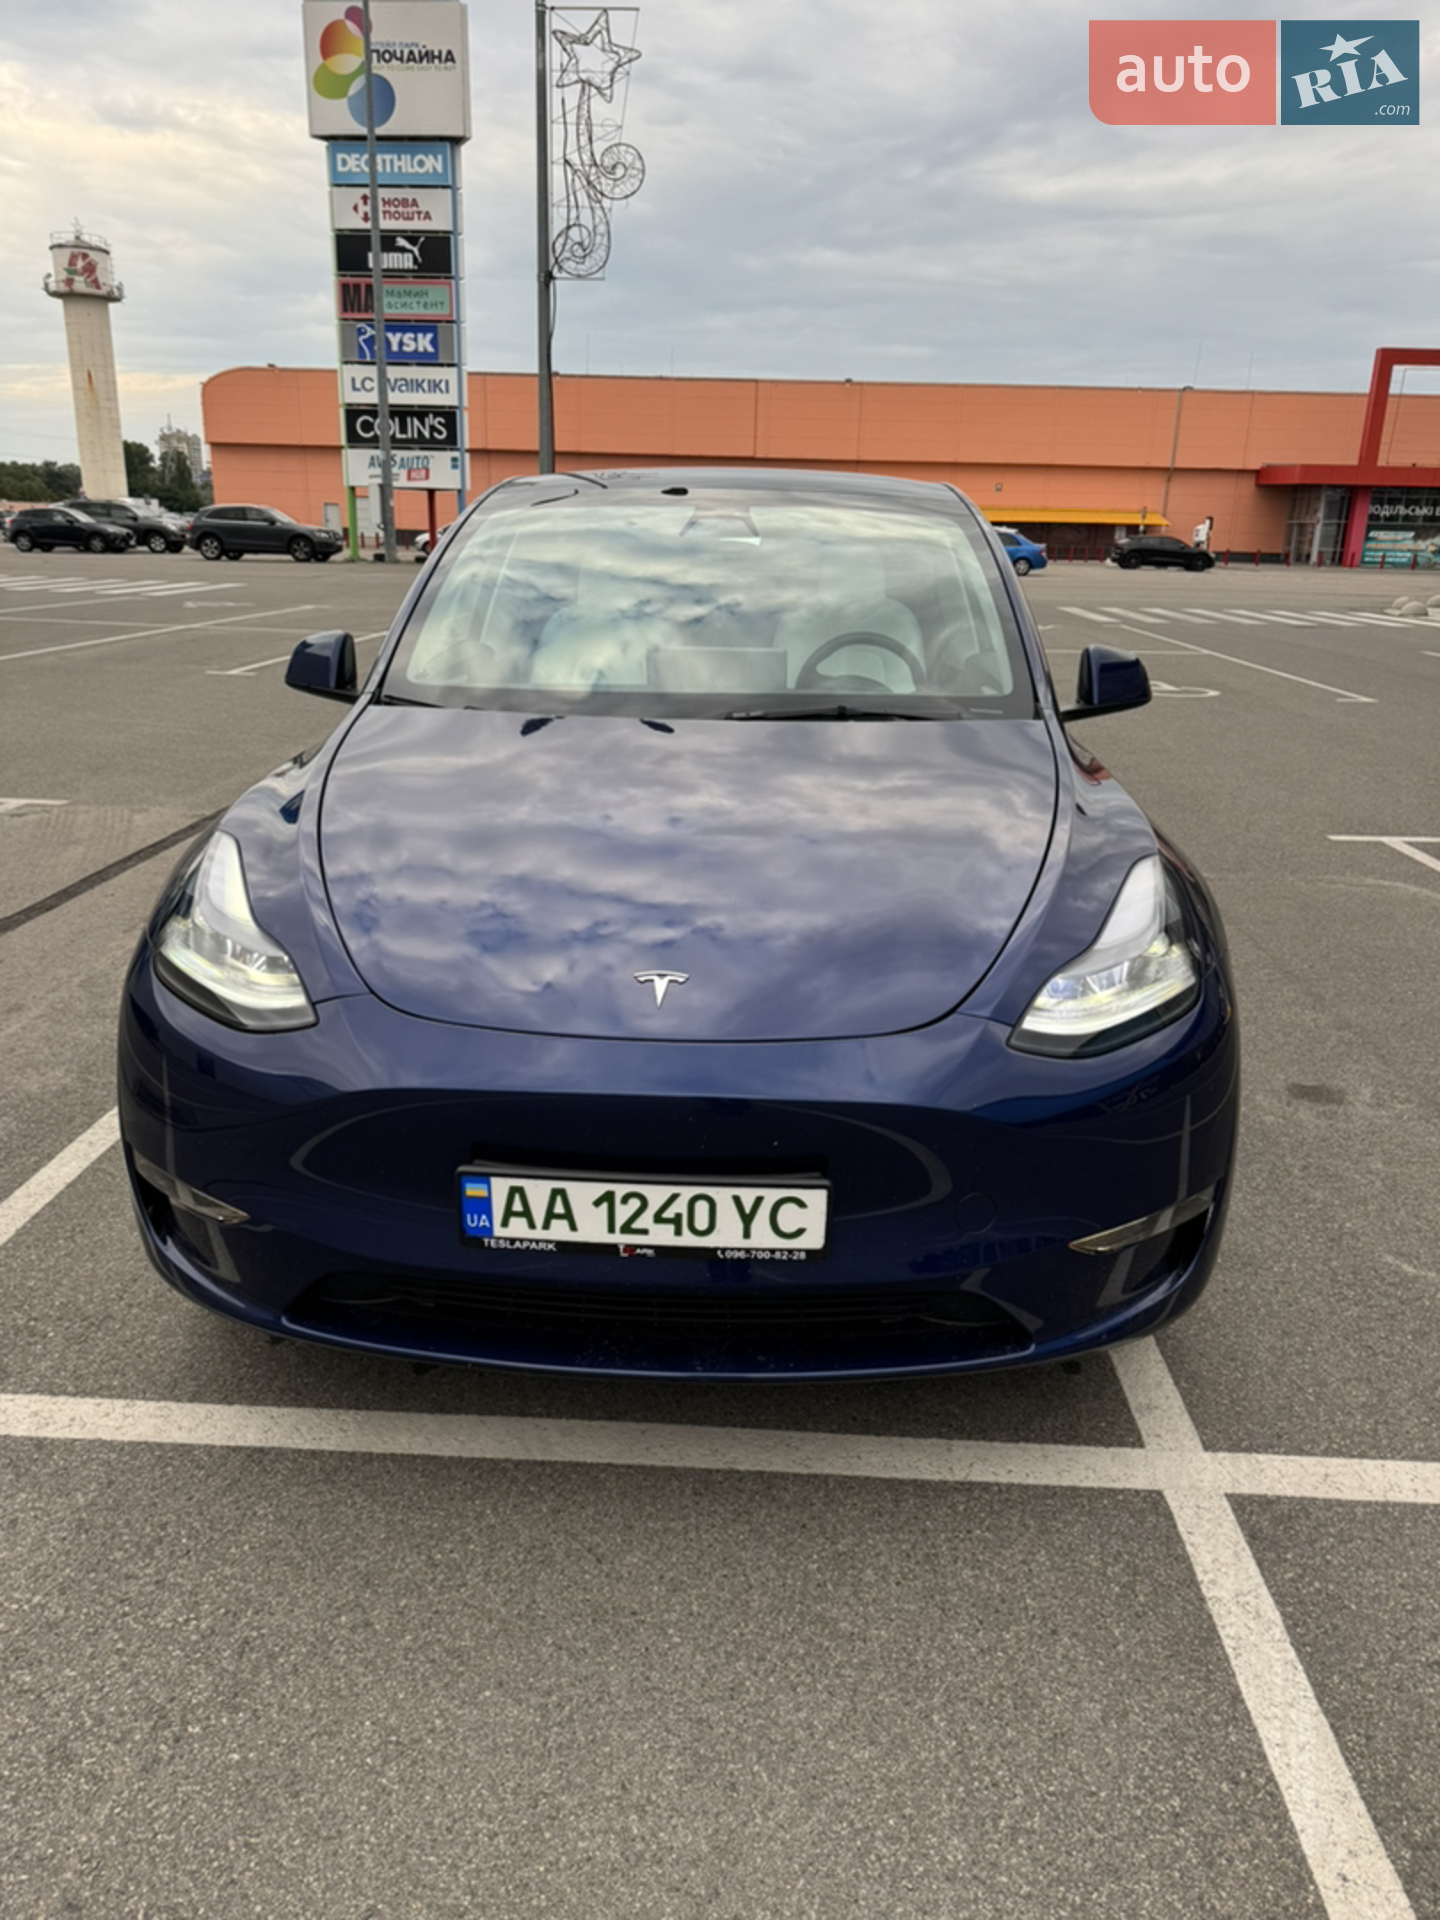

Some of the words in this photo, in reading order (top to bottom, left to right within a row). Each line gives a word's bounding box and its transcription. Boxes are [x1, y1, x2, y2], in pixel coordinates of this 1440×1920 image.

[371, 44, 456, 65] ПОЧАЙНА
[381, 197, 420, 208] НОВА
[381, 210, 432, 221] ПОШТА
[374, 332, 436, 353] YSK
[351, 376, 375, 393] LC
[355, 413, 448, 440] COLIN'S
[466, 1213, 491, 1228] UA
[500, 1185, 578, 1232] AA
[592, 1190, 717, 1238] 1240
[731, 1195, 808, 1240] YC
[483, 1237, 557, 1252] TESLAPARK
